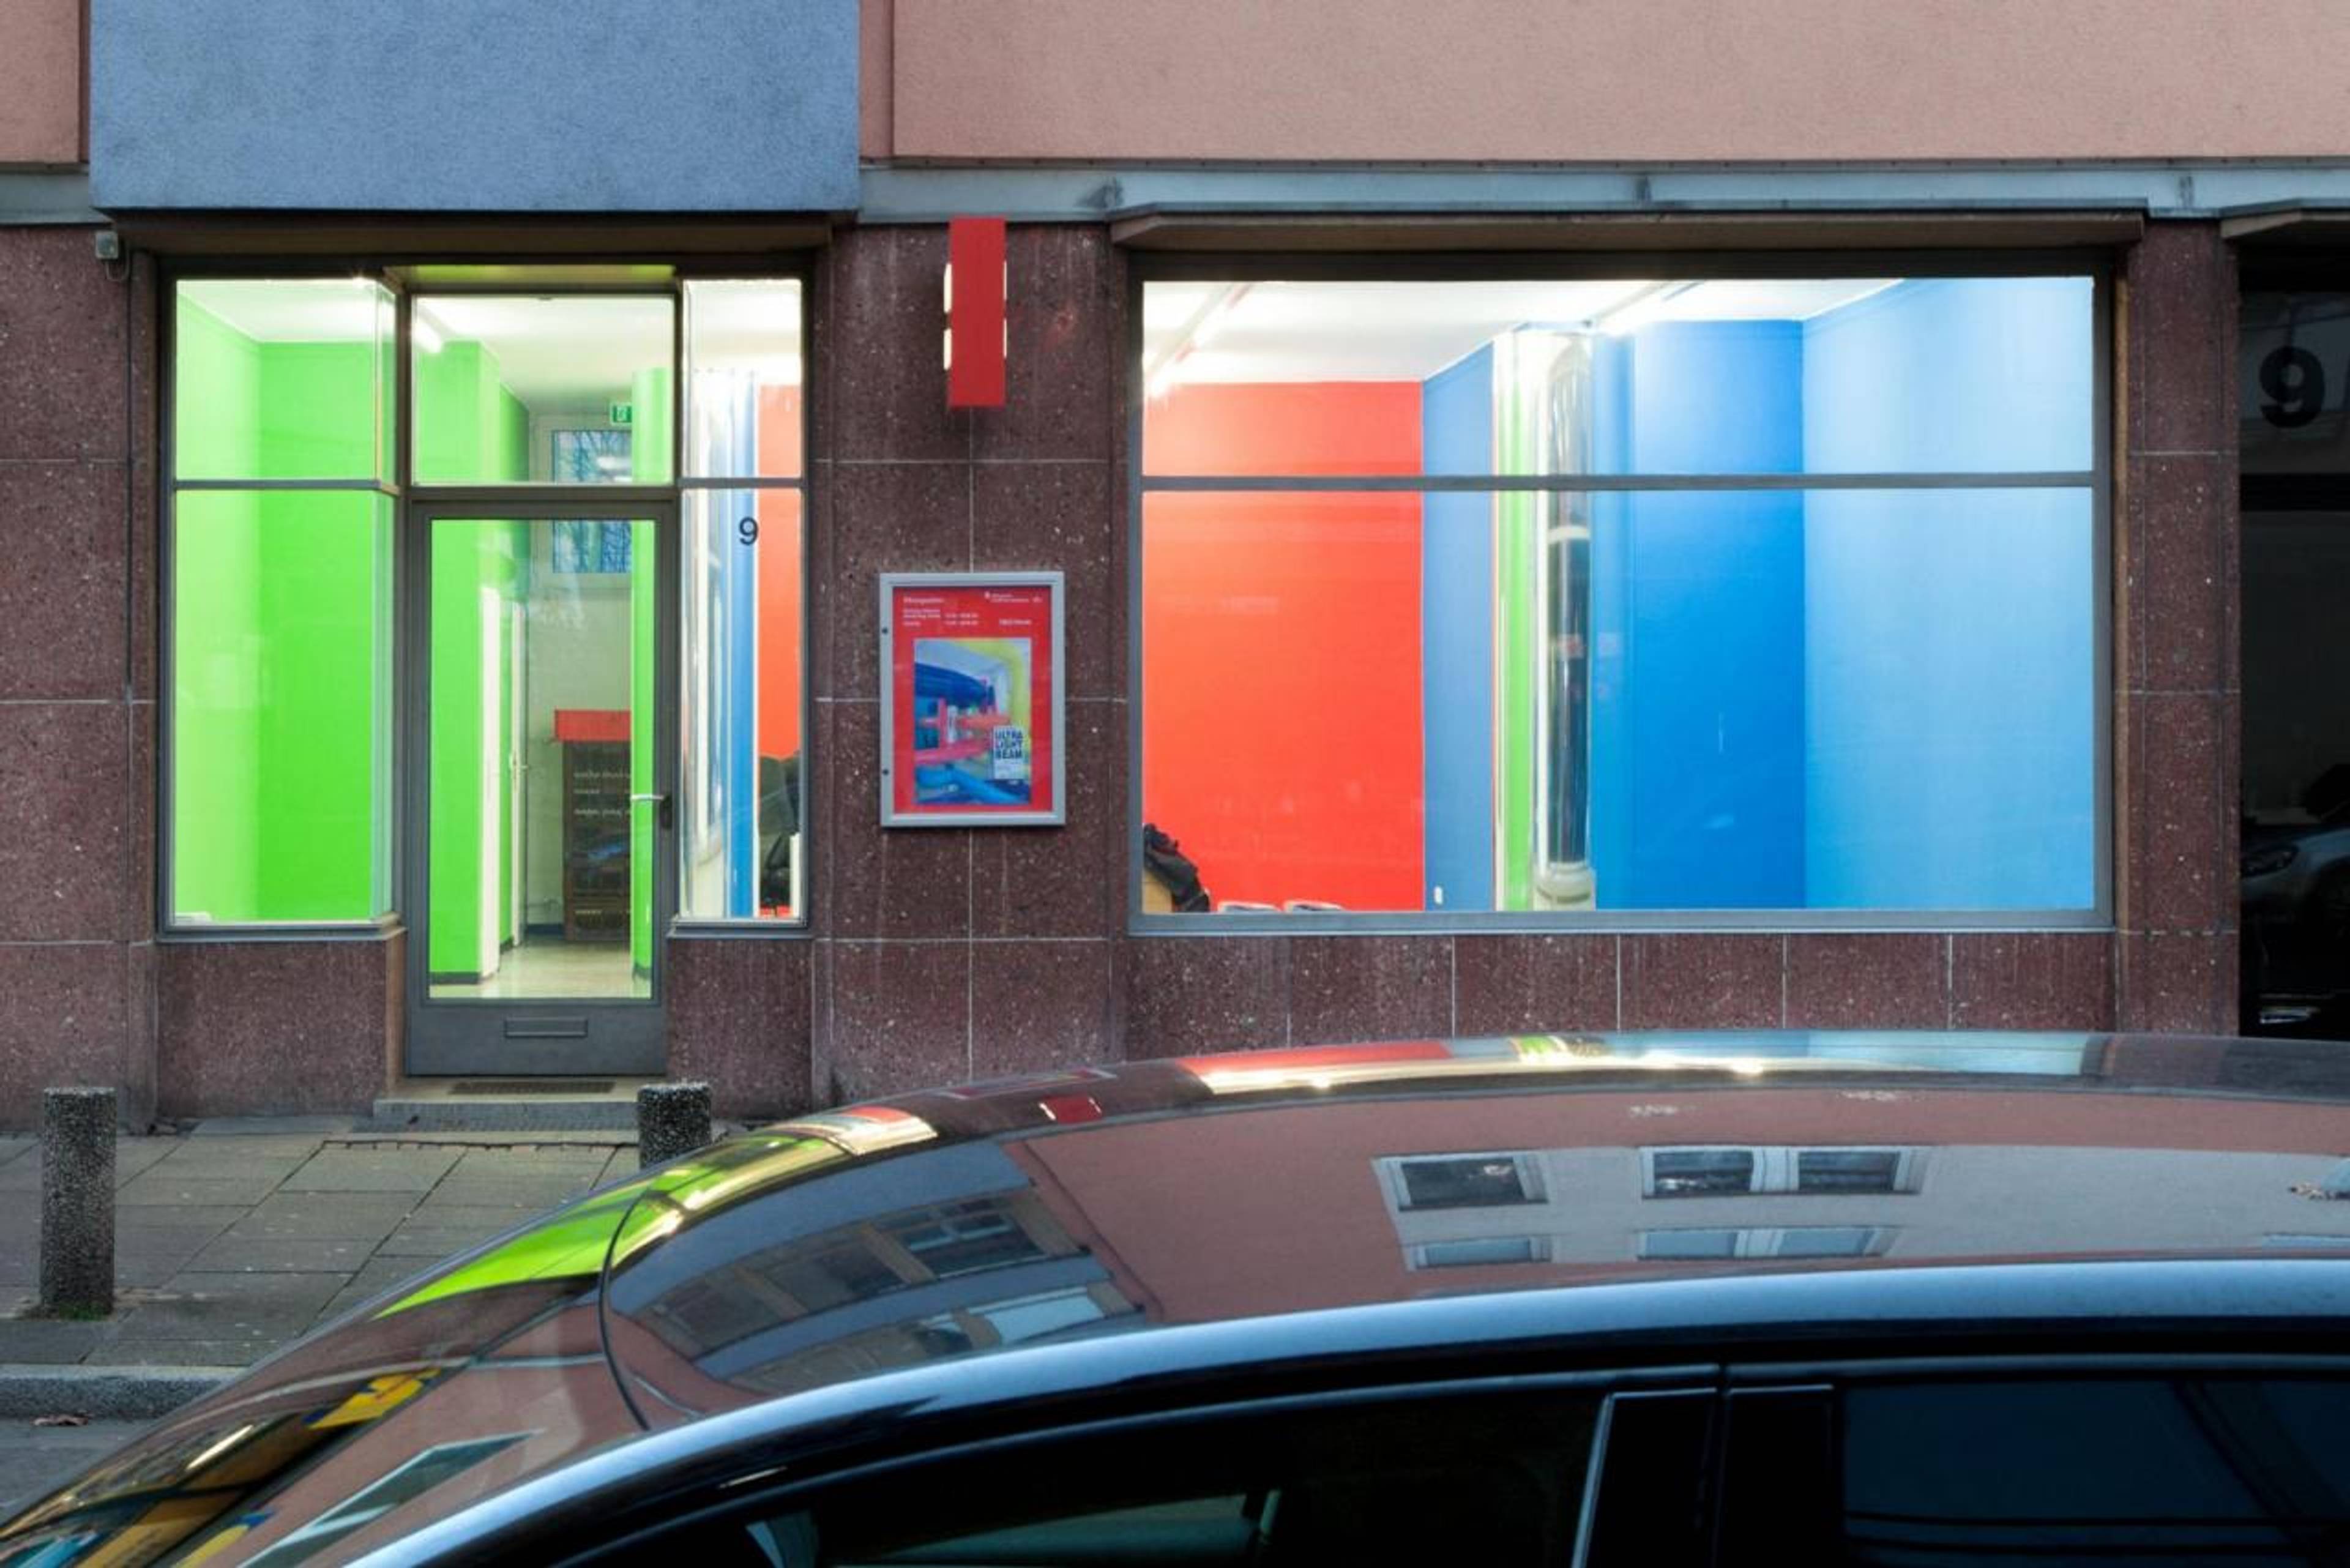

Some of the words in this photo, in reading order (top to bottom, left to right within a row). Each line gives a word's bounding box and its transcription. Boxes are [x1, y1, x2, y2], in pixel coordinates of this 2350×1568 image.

[2259, 345, 2325, 428] 9
[739, 516, 759, 546] 9
[995, 739, 1023, 748] LIGHT
[995, 749, 1023, 758] BEAM
